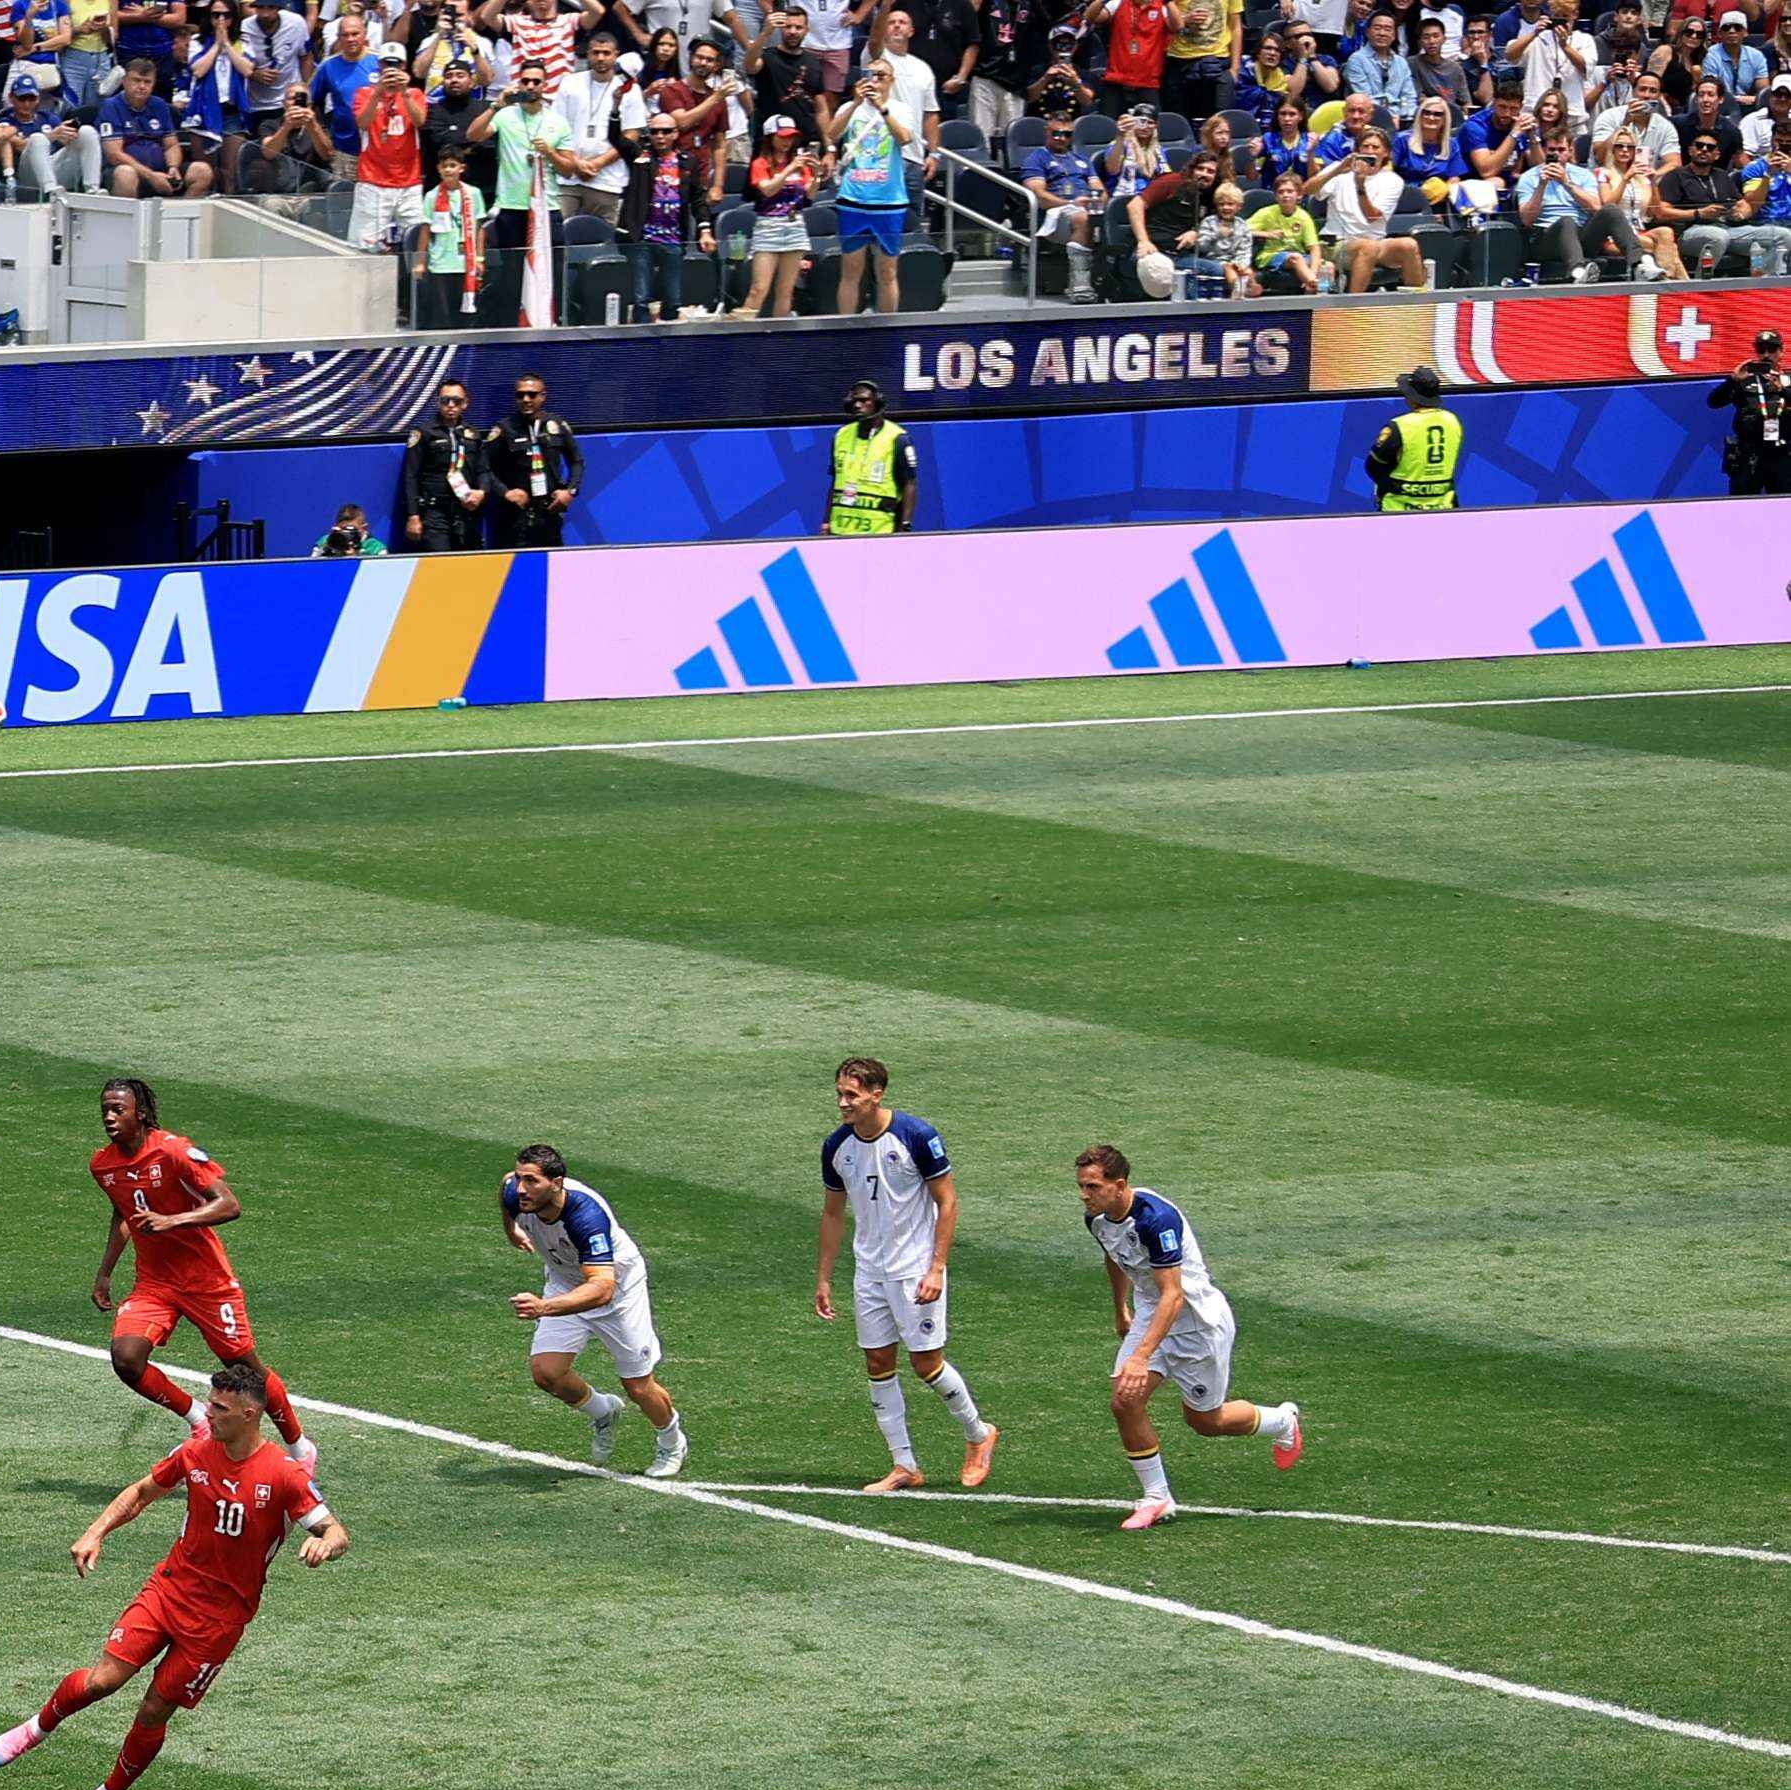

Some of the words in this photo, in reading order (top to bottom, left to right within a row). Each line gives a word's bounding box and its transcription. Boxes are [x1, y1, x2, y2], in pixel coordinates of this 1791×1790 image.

[903, 339, 1016, 392] LOS
[1030, 328, 1291, 385] ANGELES
[866, 1175, 879, 1200] 7
[220, 1302, 237, 1335] 9
[214, 1500, 245, 1537] 10
